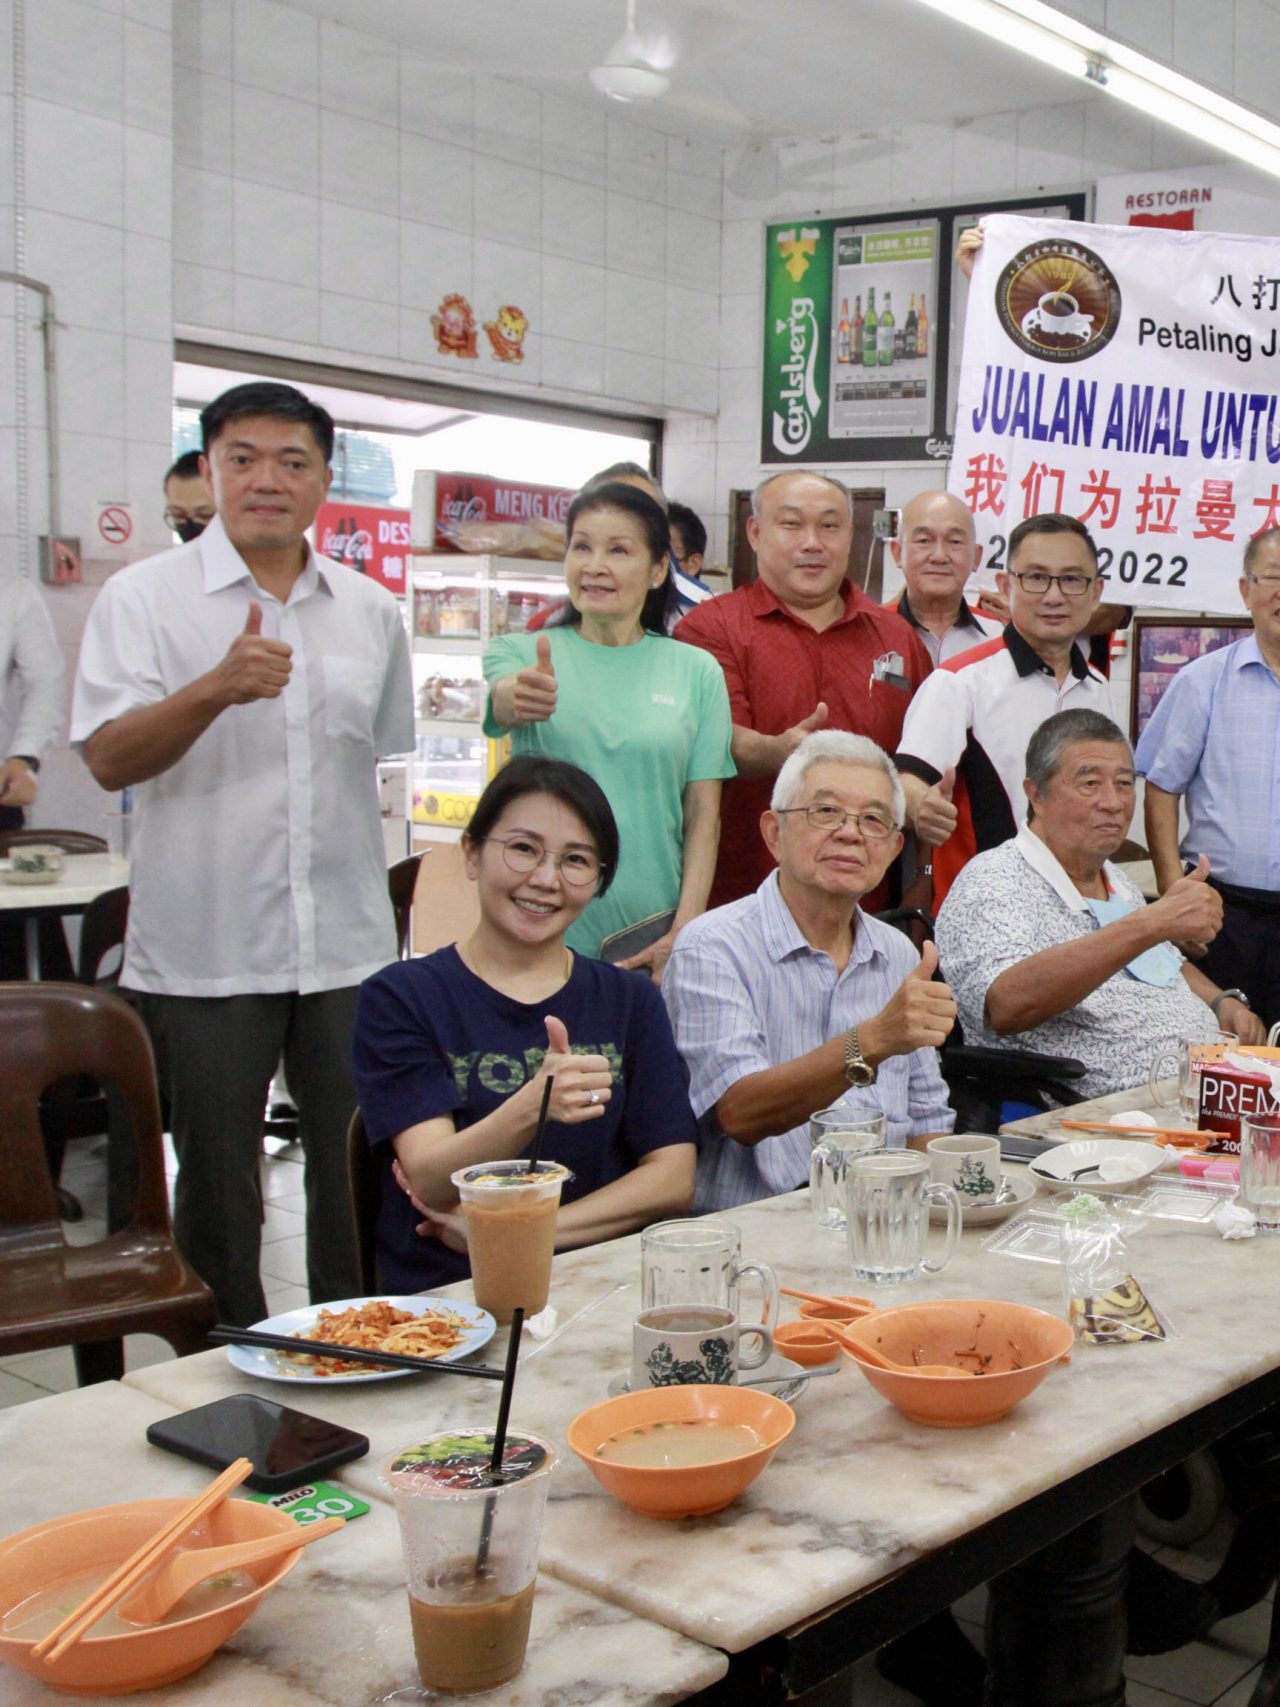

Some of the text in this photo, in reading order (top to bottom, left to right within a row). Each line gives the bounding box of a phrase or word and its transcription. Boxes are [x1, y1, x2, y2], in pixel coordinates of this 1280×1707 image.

[1139, 318, 1251, 362] Petaling
[773, 297, 822, 456] Carlsberg
[972, 364, 1098, 447] JUALAN
[1102, 383, 1189, 457] AMAL
[494, 488, 572, 520] MENG KE
[272, 1488, 314, 1508] MILO
[289, 1498, 354, 1525] 30
